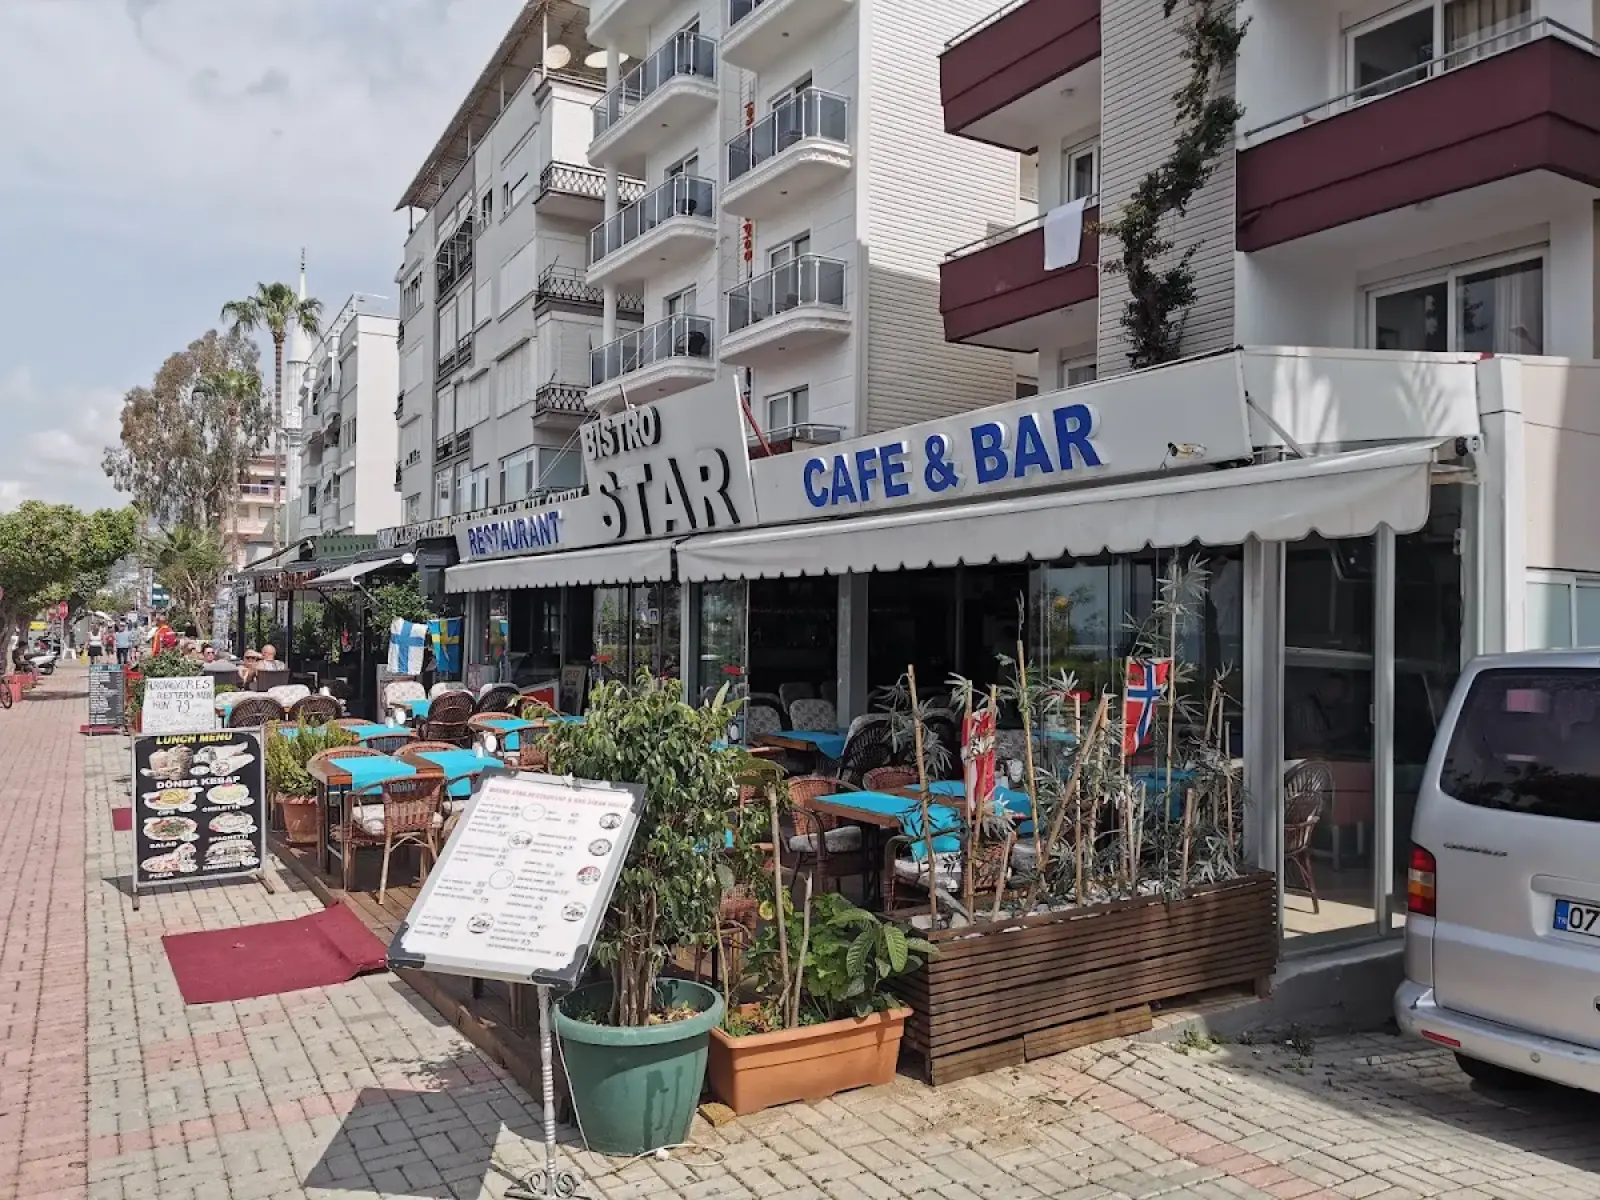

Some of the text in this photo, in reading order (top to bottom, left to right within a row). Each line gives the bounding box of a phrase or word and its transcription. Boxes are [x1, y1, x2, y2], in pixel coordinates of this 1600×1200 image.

[580, 405, 662, 461] BISTRO
[803, 403, 1108, 508] CAFE & BAR
[597, 448, 741, 539] STAR
[467, 508, 564, 557] RESTAURANT
[155, 732, 233, 745] LUNCH MENU
[201, 776, 241, 785] KEBAP
[148, 871, 174, 880] PIZZA
[1570, 907, 1600, 932] 07
